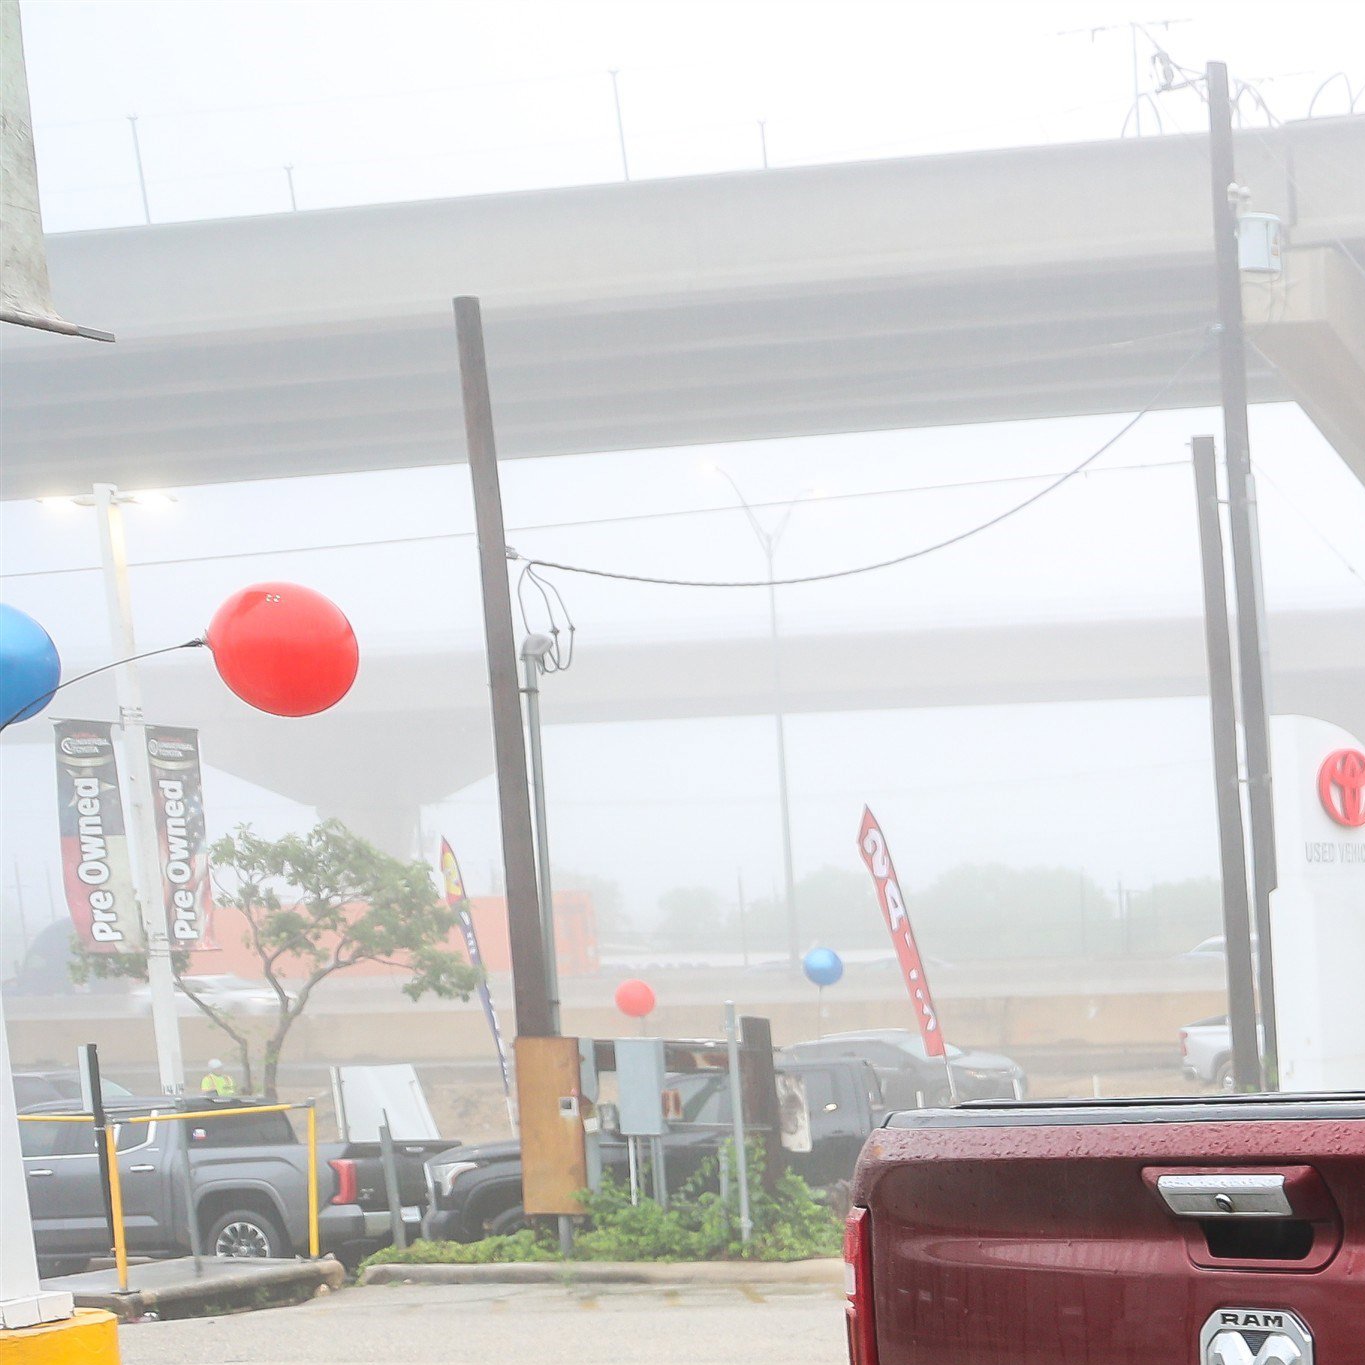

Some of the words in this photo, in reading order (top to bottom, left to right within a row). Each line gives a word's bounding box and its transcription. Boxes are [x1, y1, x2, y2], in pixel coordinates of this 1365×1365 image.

[74, 777, 110, 885] Owned
[158, 779, 192, 884] Owned
[1304, 842, 1334, 863] USED
[89, 890, 123, 942] Pre
[174, 889, 199, 940] Pre
[1220, 1311, 1284, 1329] RAM
